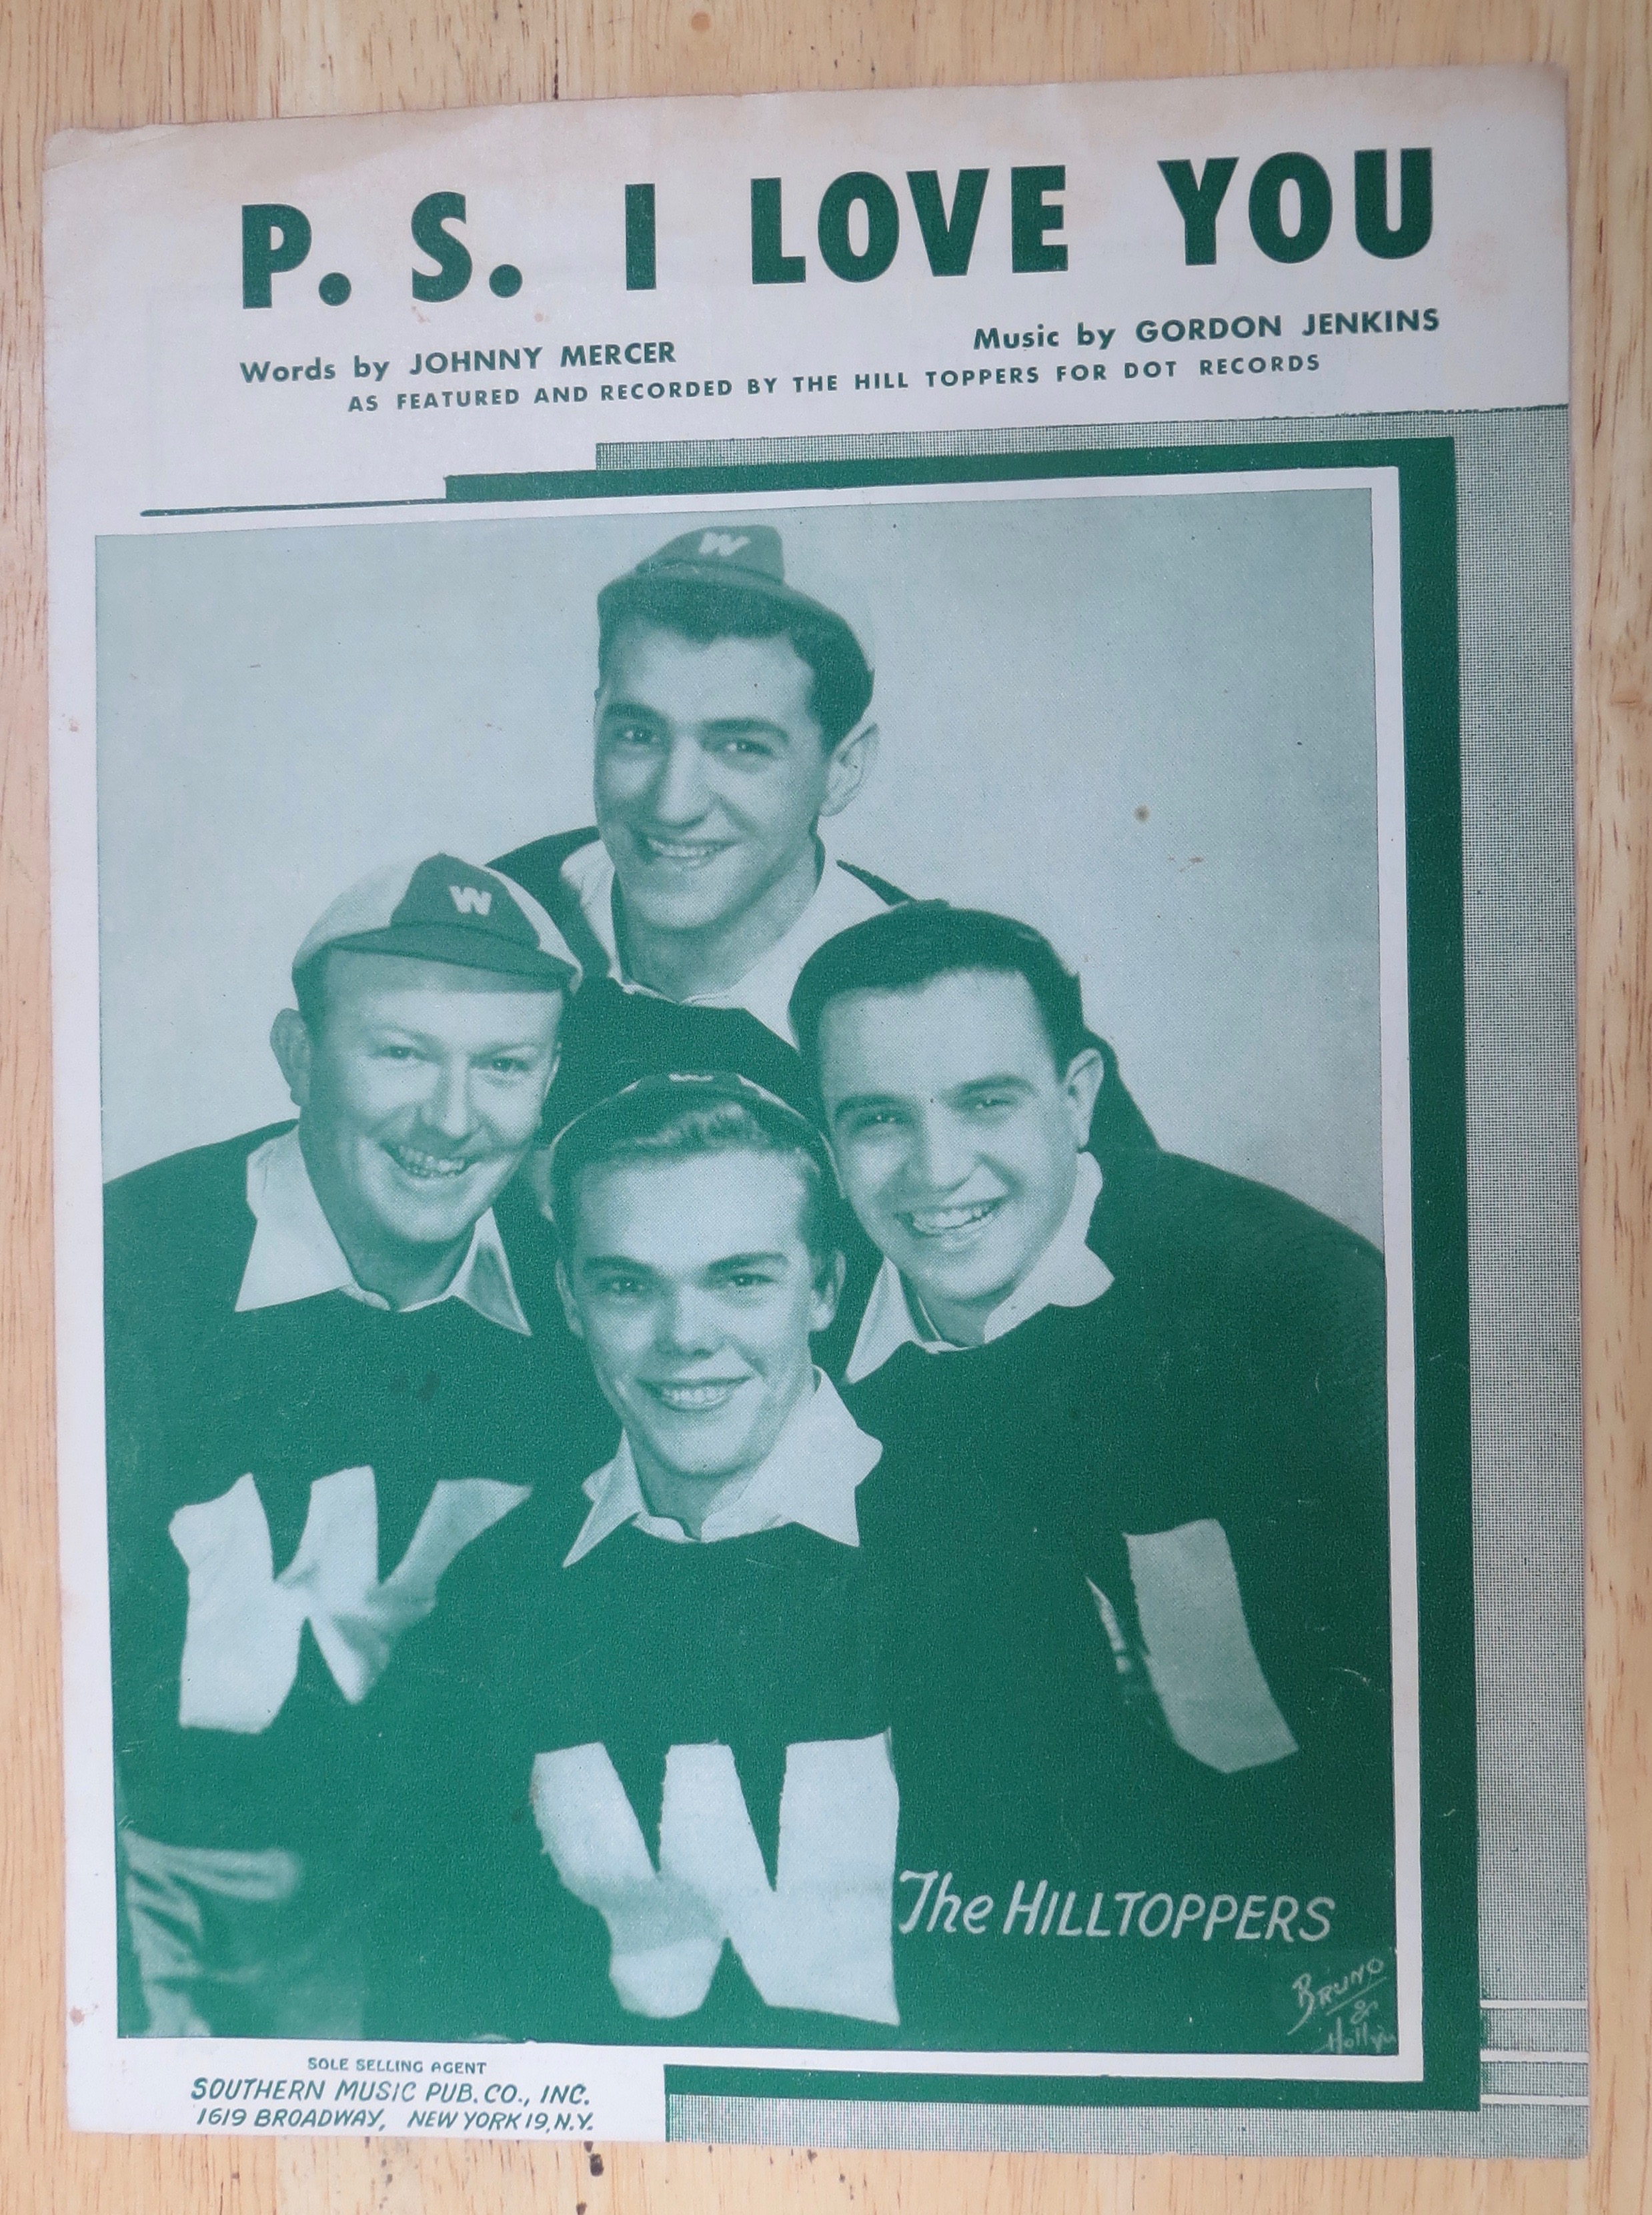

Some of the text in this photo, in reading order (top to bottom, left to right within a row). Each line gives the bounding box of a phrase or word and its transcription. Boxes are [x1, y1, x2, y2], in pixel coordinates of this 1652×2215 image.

[242, 148, 1433, 309] P. S. I LOVE YOU
[974, 308, 1439, 349] Music by GORDON JENKINS
[240, 341, 676, 383] Words by JOHNNY MERCER
[348, 354, 1319, 412] AS FEATURED AND RECORDED BY THE HILL TOPPERS FOR DOT RECORDS
[448, 885, 492, 916] W
[531, 1729, 900, 2026] W
[900, 1871, 1335, 1942] The HILLTOPPERS
[308, 2057, 486, 2074] SOLE SELLING AGENT
[191, 2078, 325, 2101] SOUTHERN
[335, 2080, 416, 2102] MUSIC
[540, 2084, 589, 2105] INC.
[197, 2108, 247, 2126] 1619
[254, 2109, 385, 2131] BROADWAY,
[407, 2110, 458, 2128] NEW
[464, 2112, 522, 2131] YORK
